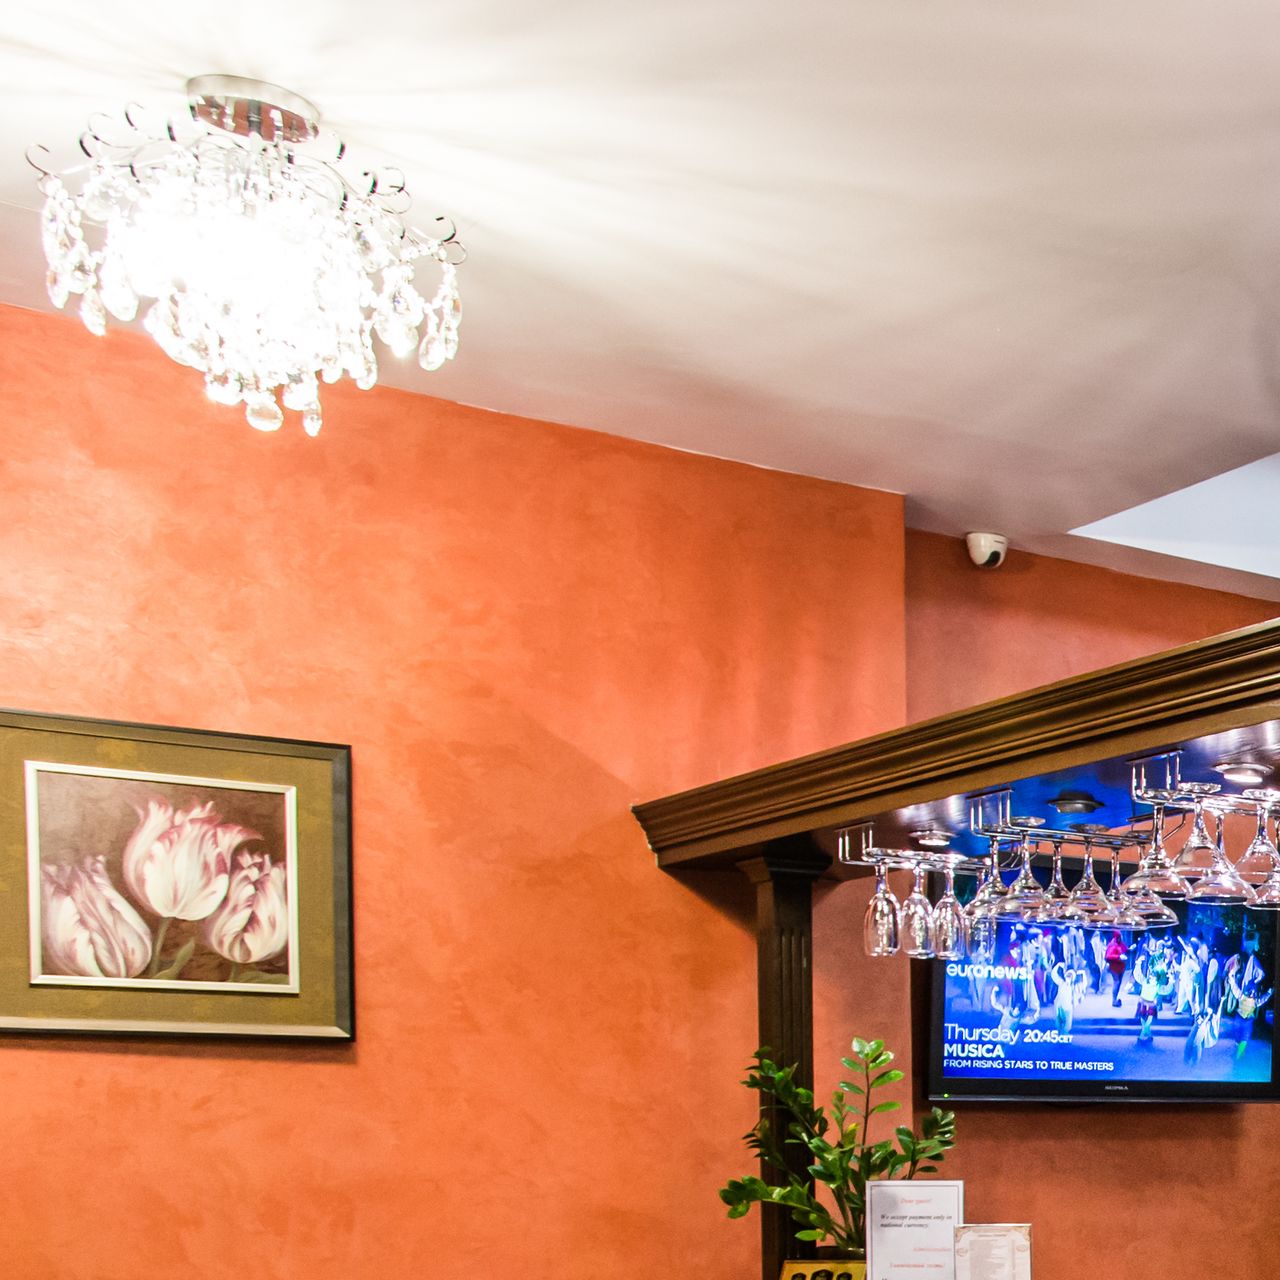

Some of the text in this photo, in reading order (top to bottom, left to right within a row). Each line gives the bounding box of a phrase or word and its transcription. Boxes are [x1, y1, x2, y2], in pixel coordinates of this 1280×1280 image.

[944, 1023, 1020, 1045] Thursday
[943, 1043, 1005, 1058] MUSICA
[943, 1059, 1114, 1071] FROM RISING STARS TO TRUE MASTERS
